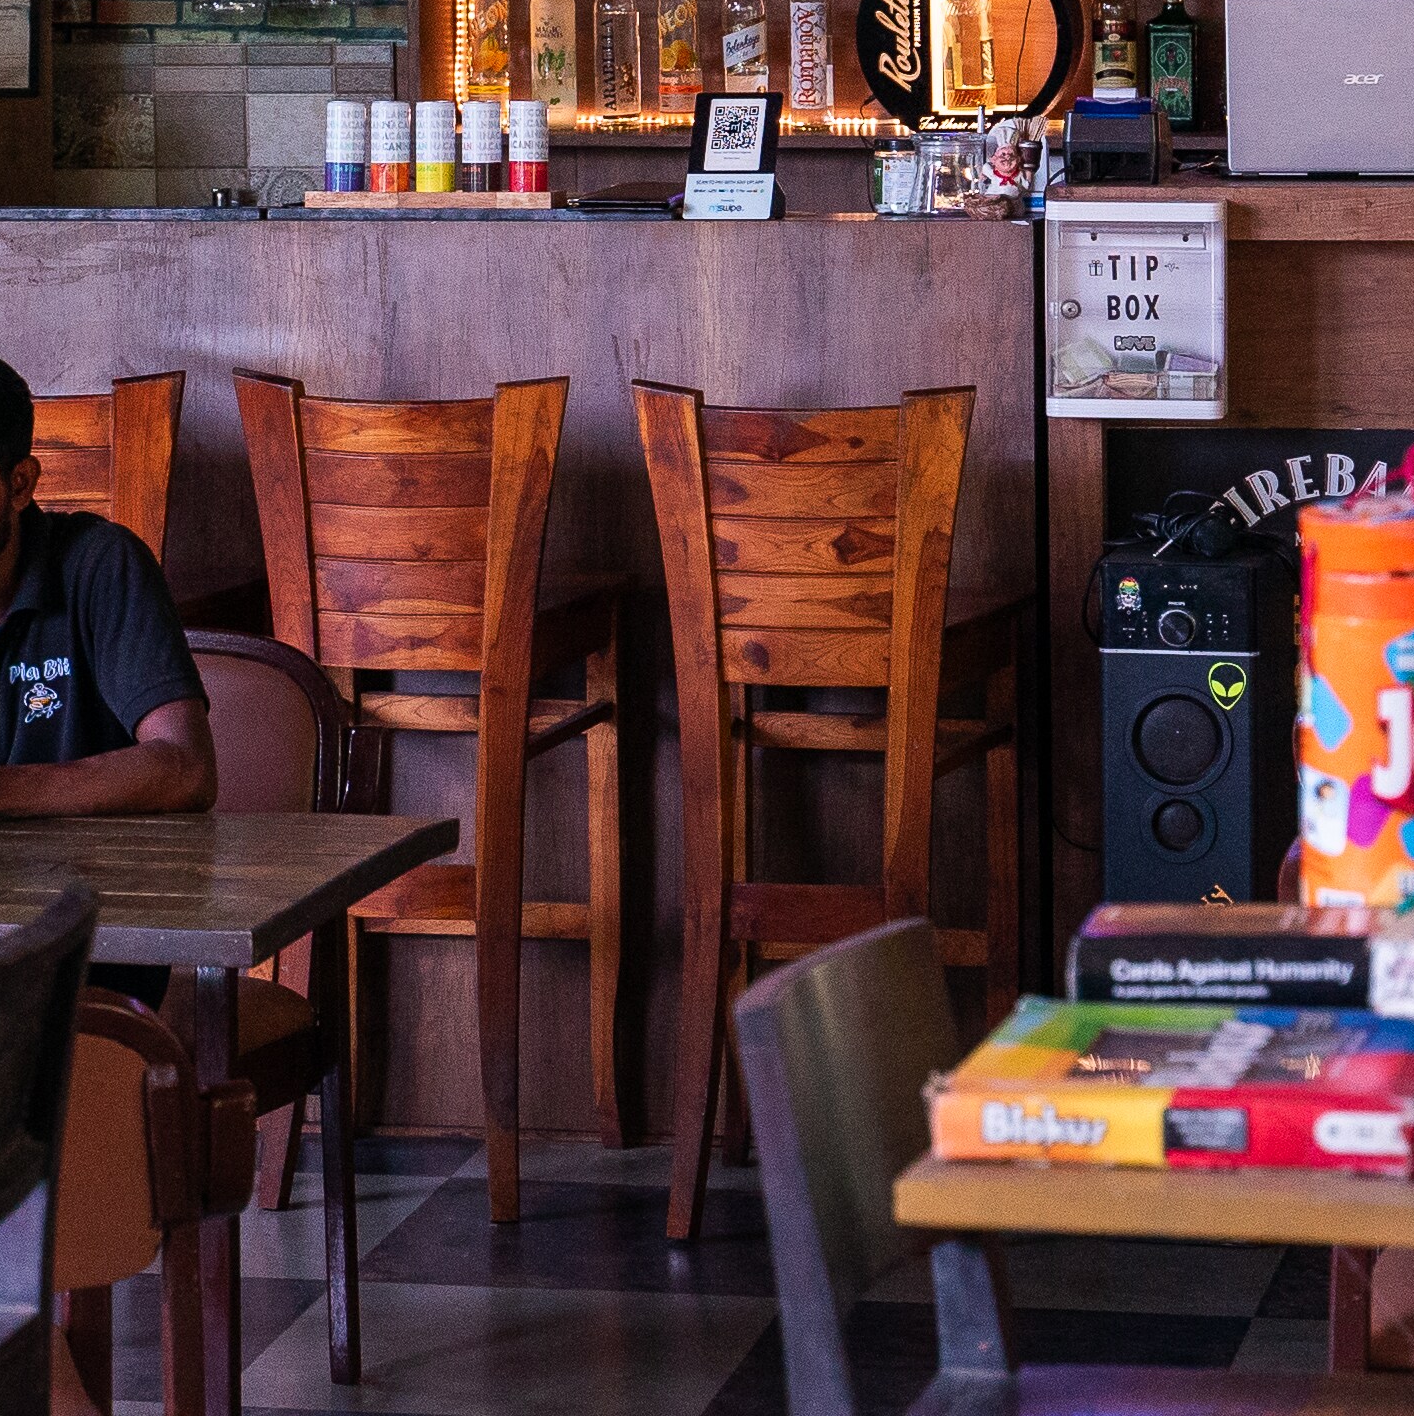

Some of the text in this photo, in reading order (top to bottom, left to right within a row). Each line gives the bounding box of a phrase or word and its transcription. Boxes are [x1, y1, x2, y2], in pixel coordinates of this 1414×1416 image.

[1344, 74, 1385, 85] acer
[1107, 255, 1159, 281] TIP
[1106, 294, 1160, 321] BOX
[1114, 335, 1156, 351] LOVE
[1110, 958, 1354, 986] Cards Against Humanity
